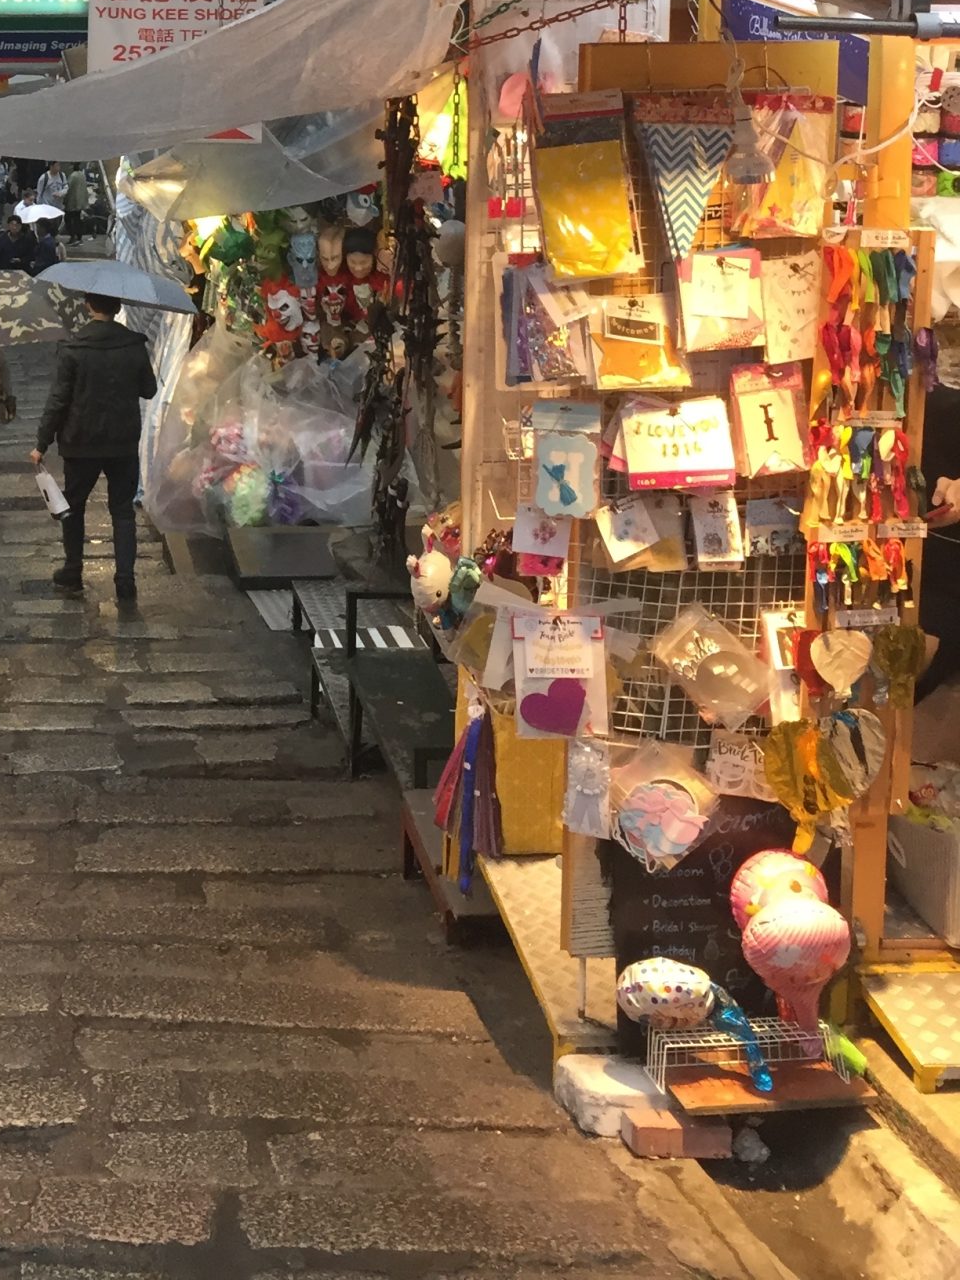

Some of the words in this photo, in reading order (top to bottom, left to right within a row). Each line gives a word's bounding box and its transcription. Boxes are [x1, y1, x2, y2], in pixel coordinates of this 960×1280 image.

[95, 7, 147, 20] YUNG
[152, 8, 189, 20] KEE
[138, 28, 175, 43] 電話
[180, 29, 208, 41] TE
[0, 40, 47, 52] Imaging
